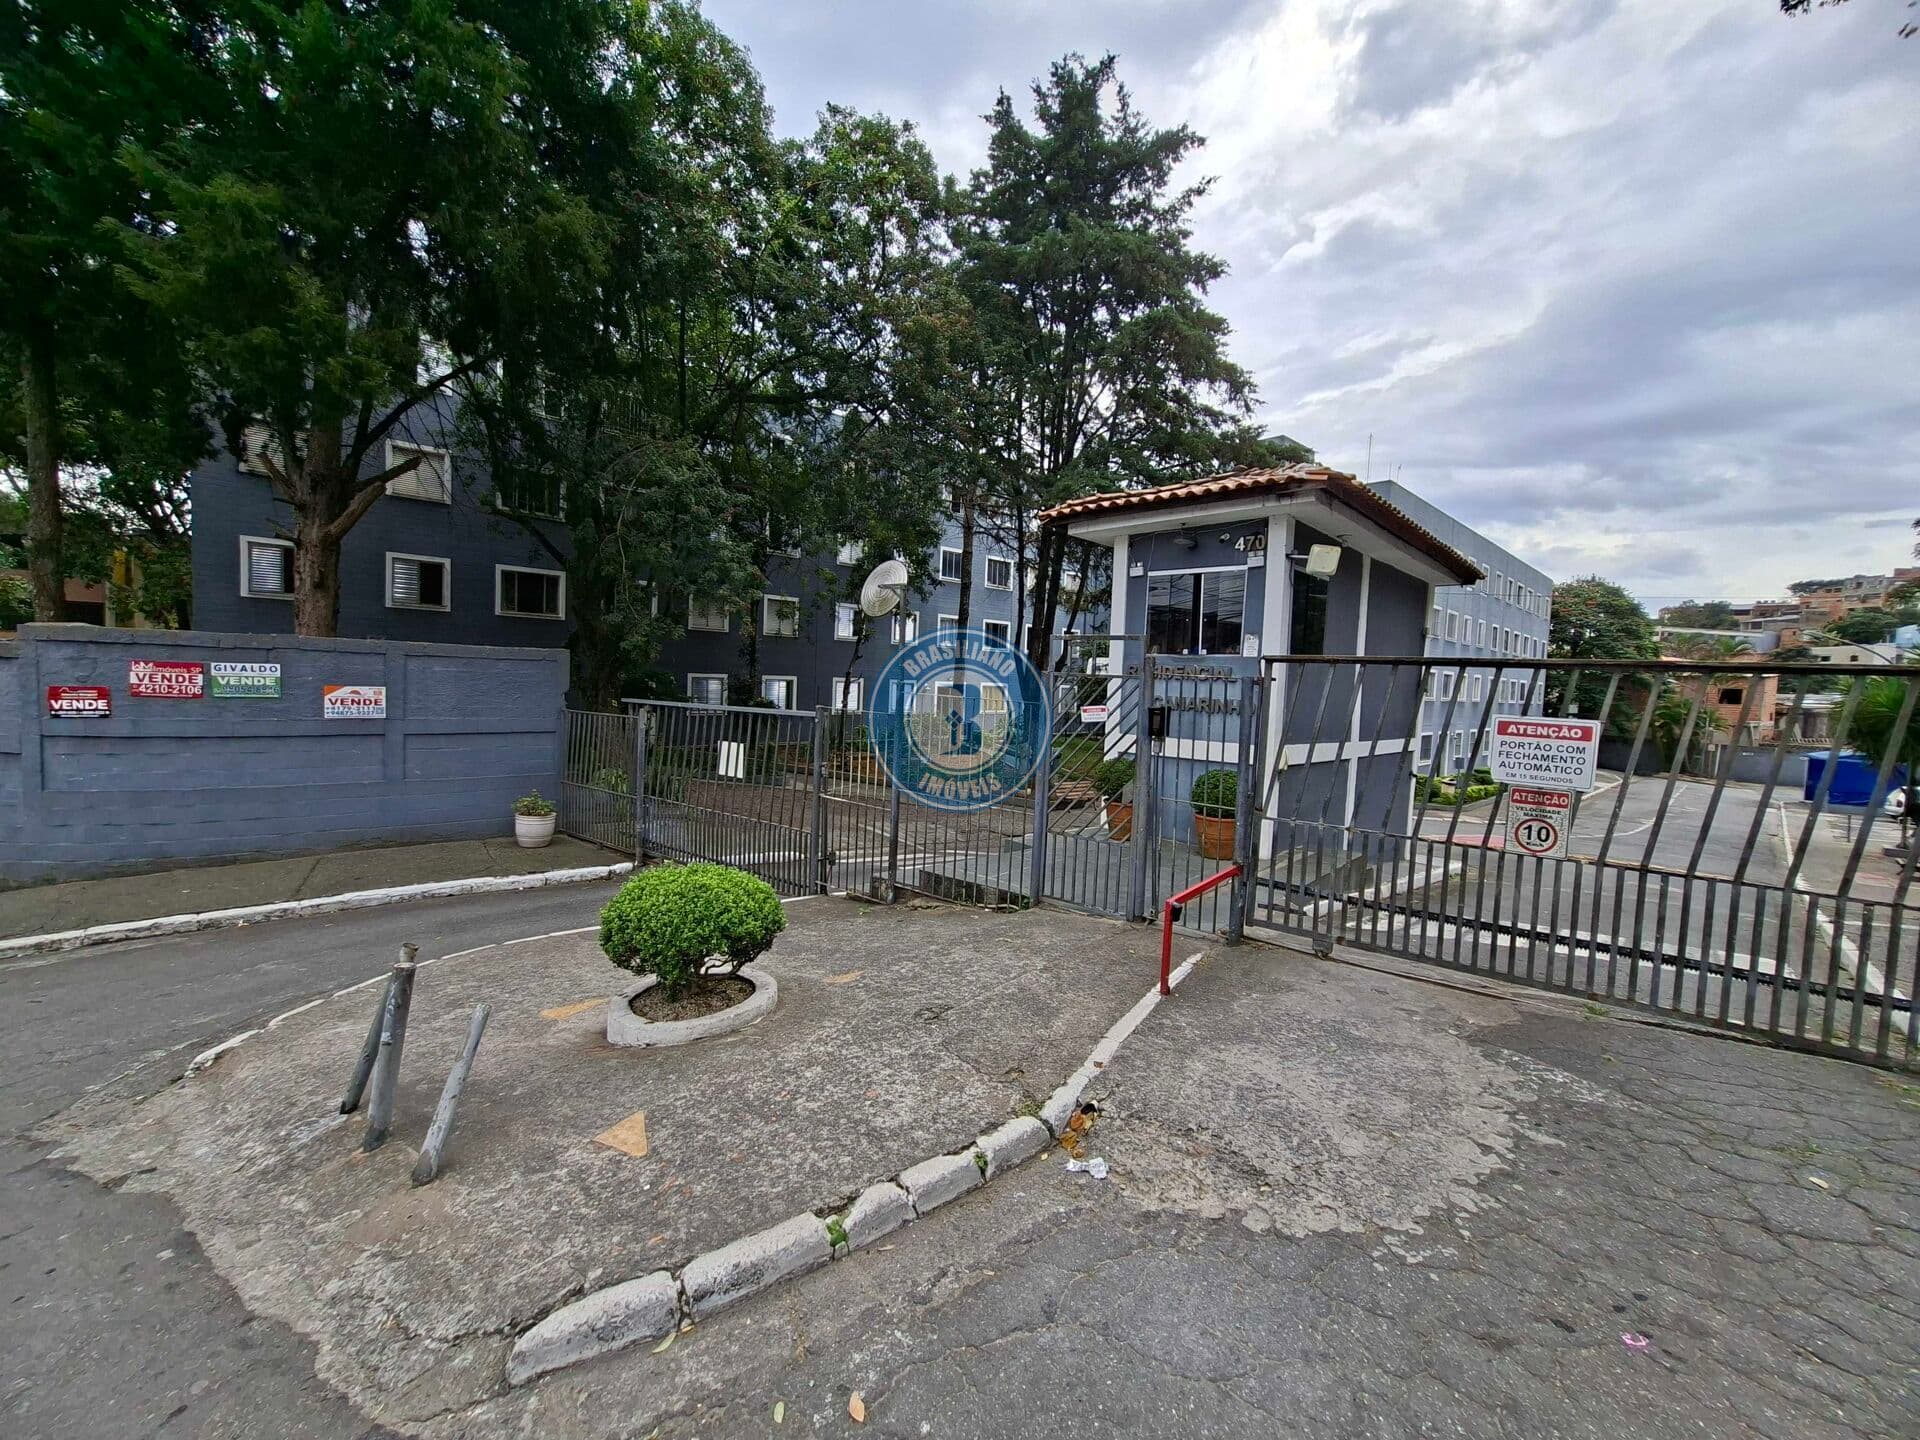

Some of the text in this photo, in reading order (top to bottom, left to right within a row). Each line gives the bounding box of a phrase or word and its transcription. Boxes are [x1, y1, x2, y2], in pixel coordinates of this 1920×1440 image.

[1234, 535, 1265, 551] 470
[213, 664, 278, 673] GIVALDO
[1128, 664, 1238, 682] RSIDENCIAL
[135, 673, 199, 685] VENDE
[217, 676, 276, 686] VENDE
[139, 684, 202, 694] 4210-2106
[50, 699, 109, 710] VENDE
[328, 698, 383, 706] VENDE
[1507, 724, 1583, 739] ATENÇÃO
[1500, 740, 1586, 755] PORTÃO COM
[1498, 750, 1586, 765] FECHAMENTO
[1529, 775, 1573, 784] SEGUNDOS
[1513, 792, 1568, 805] ATENÇÃO
[1515, 806, 1562, 815] VELOCIDADE
[1523, 824, 1551, 843] 10
